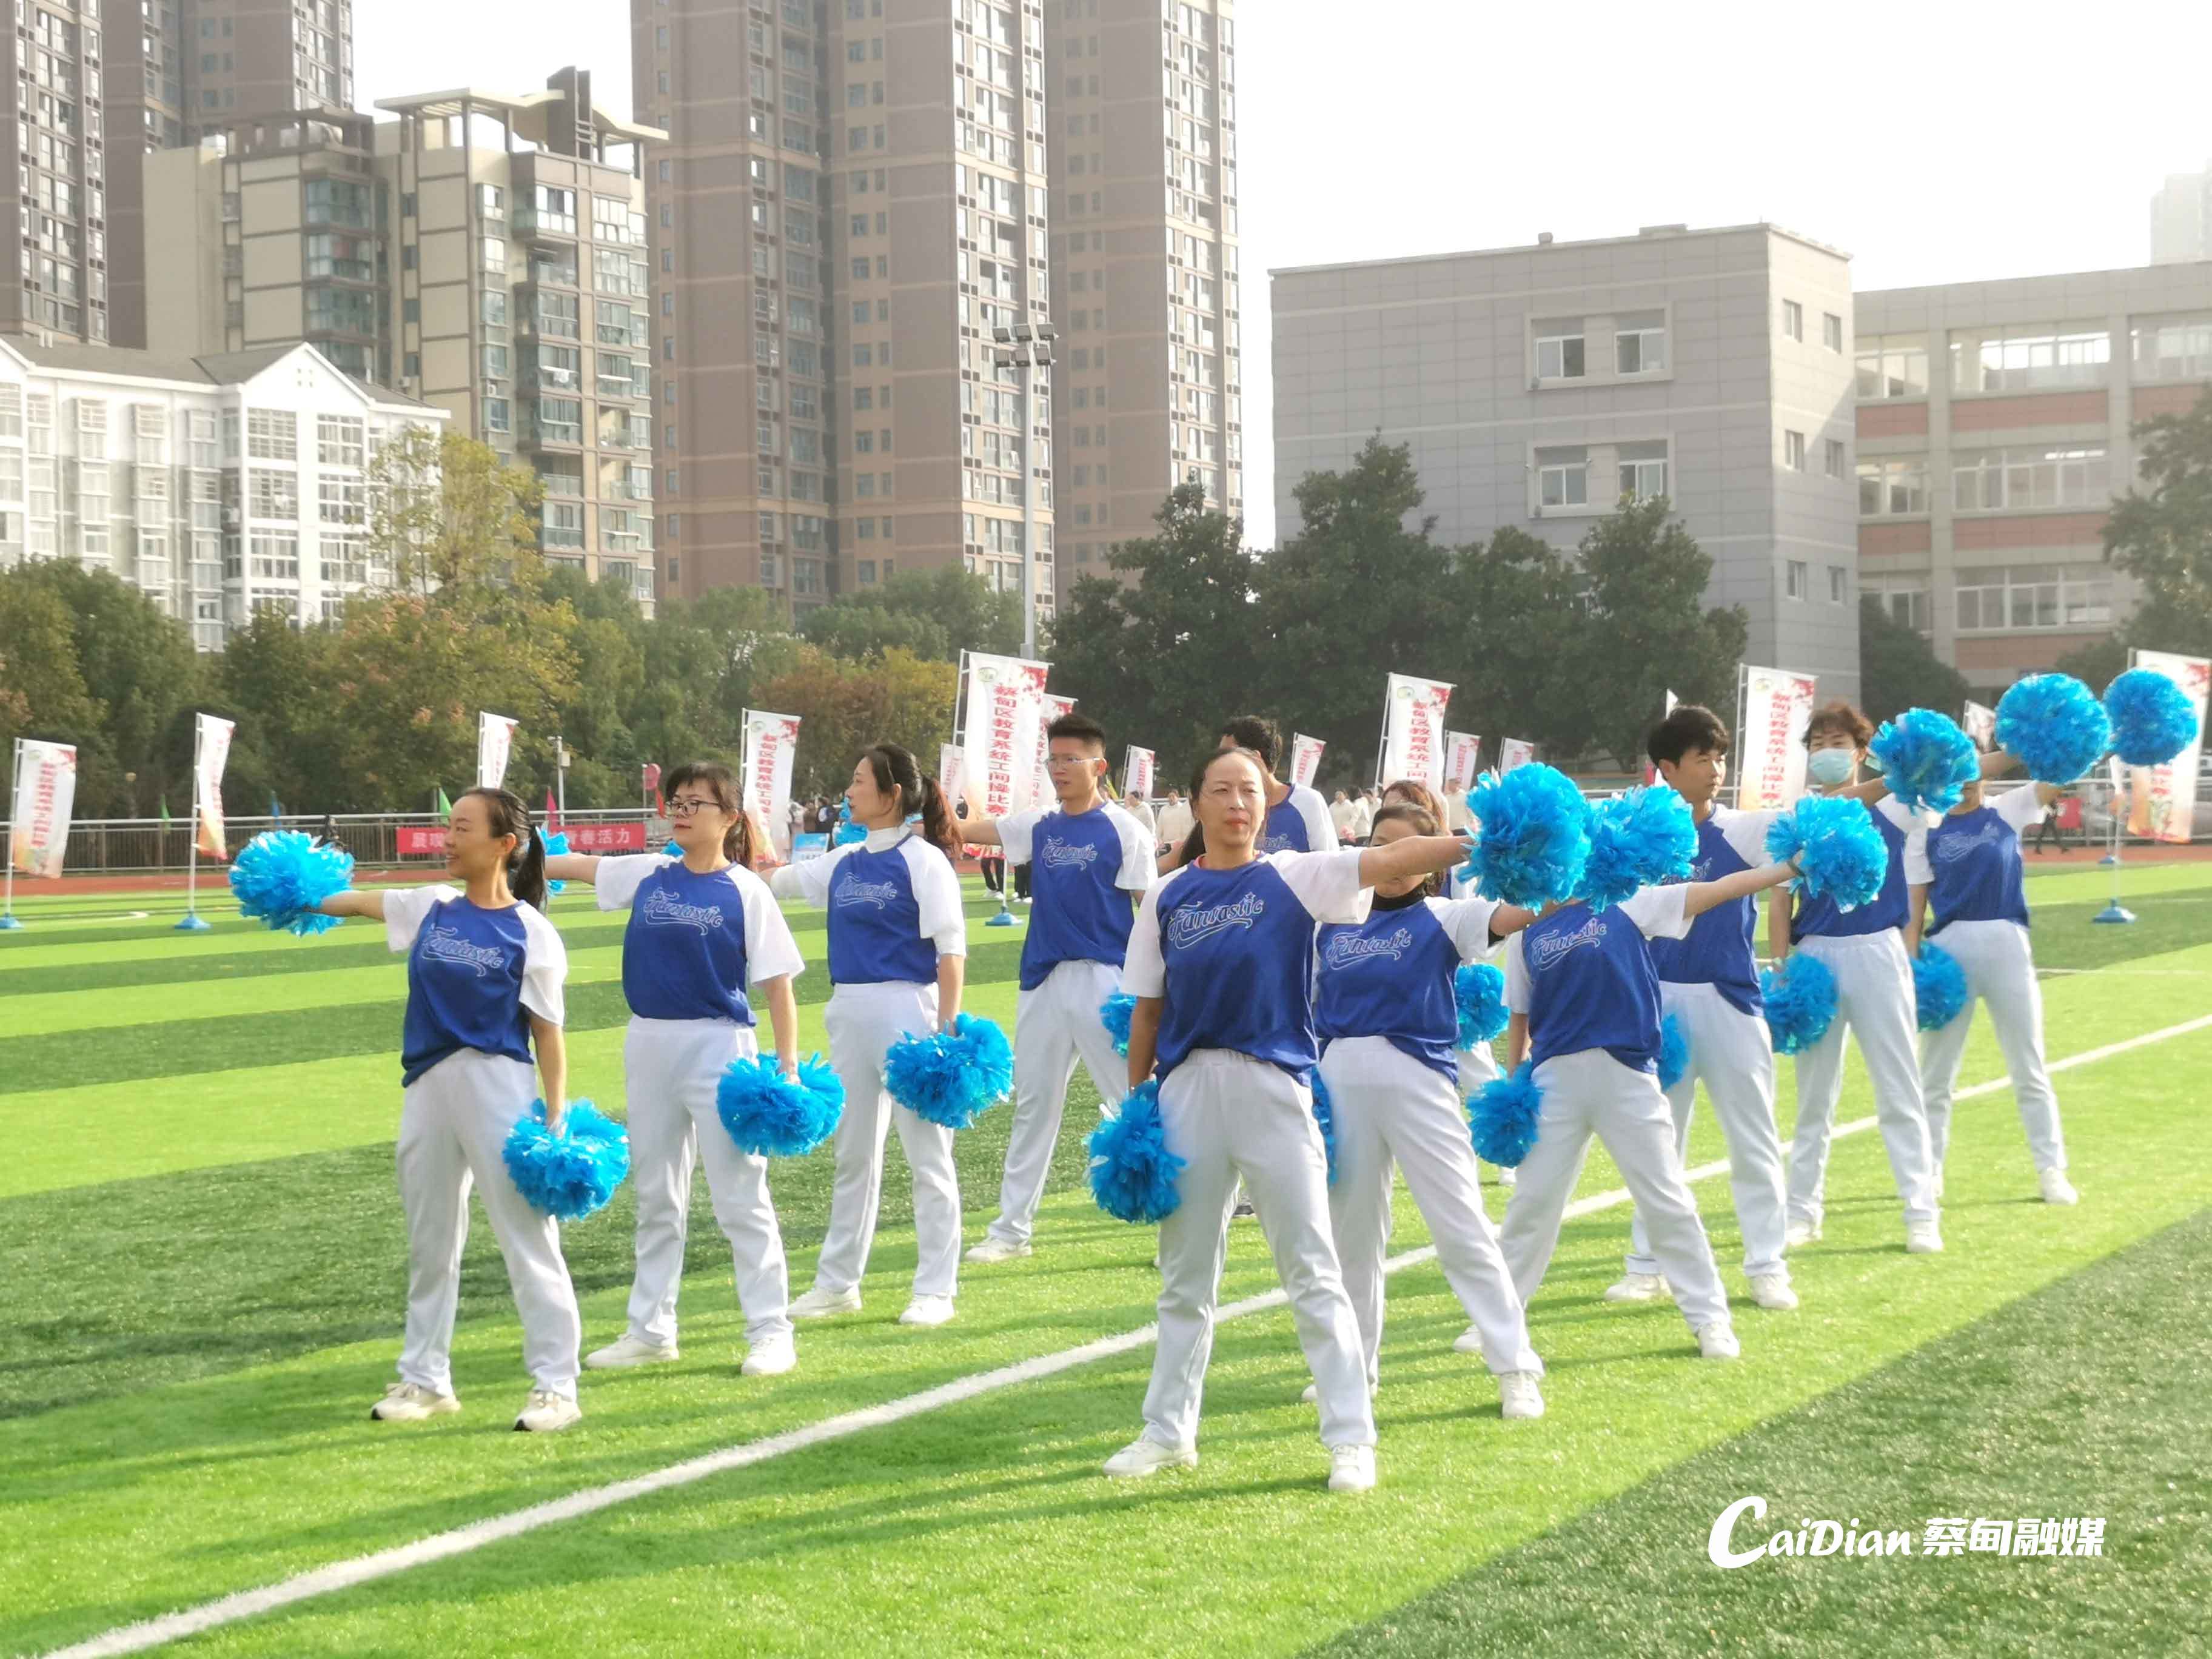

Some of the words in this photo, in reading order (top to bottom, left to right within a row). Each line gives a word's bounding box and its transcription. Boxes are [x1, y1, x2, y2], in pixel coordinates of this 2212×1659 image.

[985, 683, 1019, 816] 蔡甸区教育系统工间操比赛
[1406, 699, 1431, 785] 蔡甸区教育系统工间
[1167, 891, 1265, 950] Fantastic
[1326, 928, 1413, 970] Fantastic
[1531, 917, 1607, 971] Fantastic
